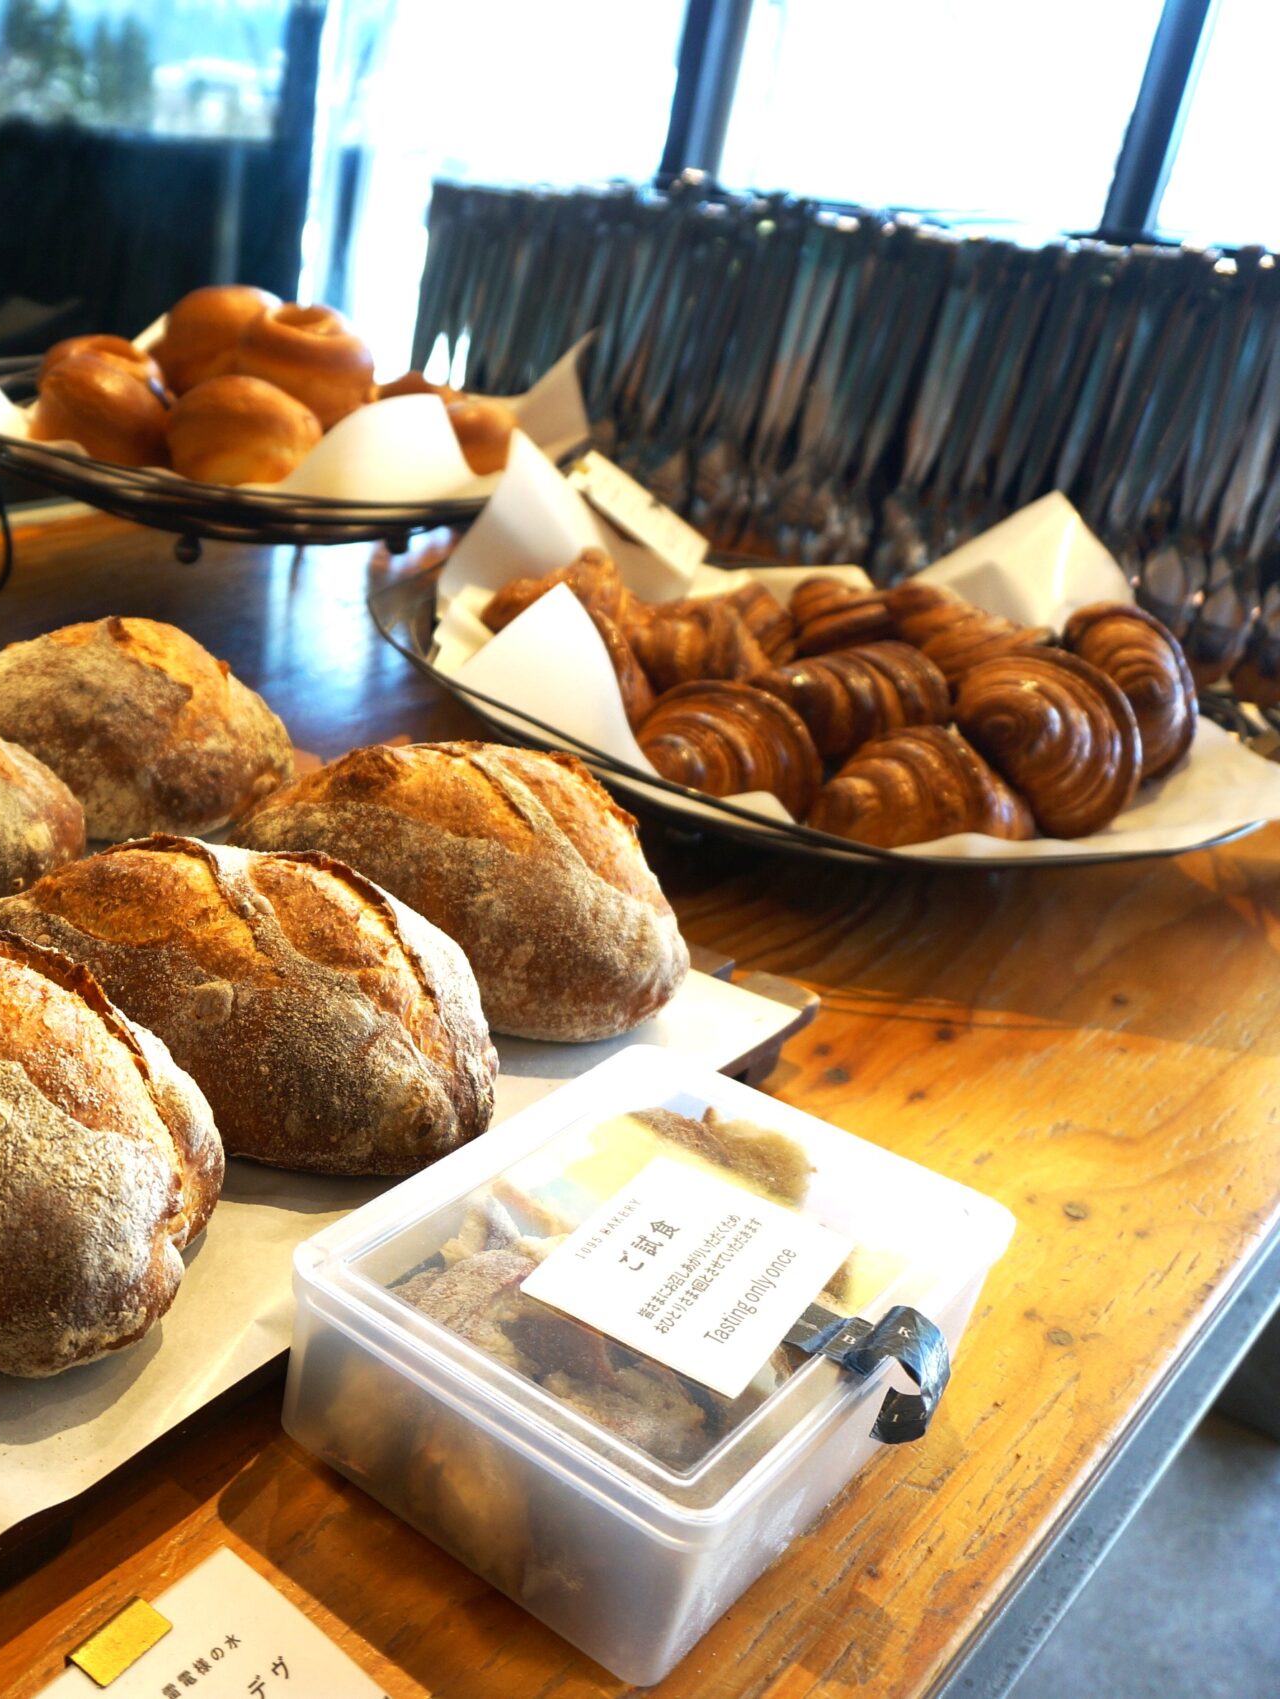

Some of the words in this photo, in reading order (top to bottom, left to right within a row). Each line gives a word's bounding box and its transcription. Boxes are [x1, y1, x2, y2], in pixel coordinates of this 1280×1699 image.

[575, 1235, 604, 1260] 1095
[602, 1198, 642, 1235] BAKERY
[618, 1219, 681, 1271] ご試食
[636, 1214, 741, 1320] 皆さまにお召しあがりいただくため
[703, 1300, 758, 1345] Tasting
[746, 1273, 778, 1304] only
[765, 1247, 797, 1278] once
[161, 1633, 242, 1699] 雷電様の水
[247, 1655, 290, 1699] デヴ
